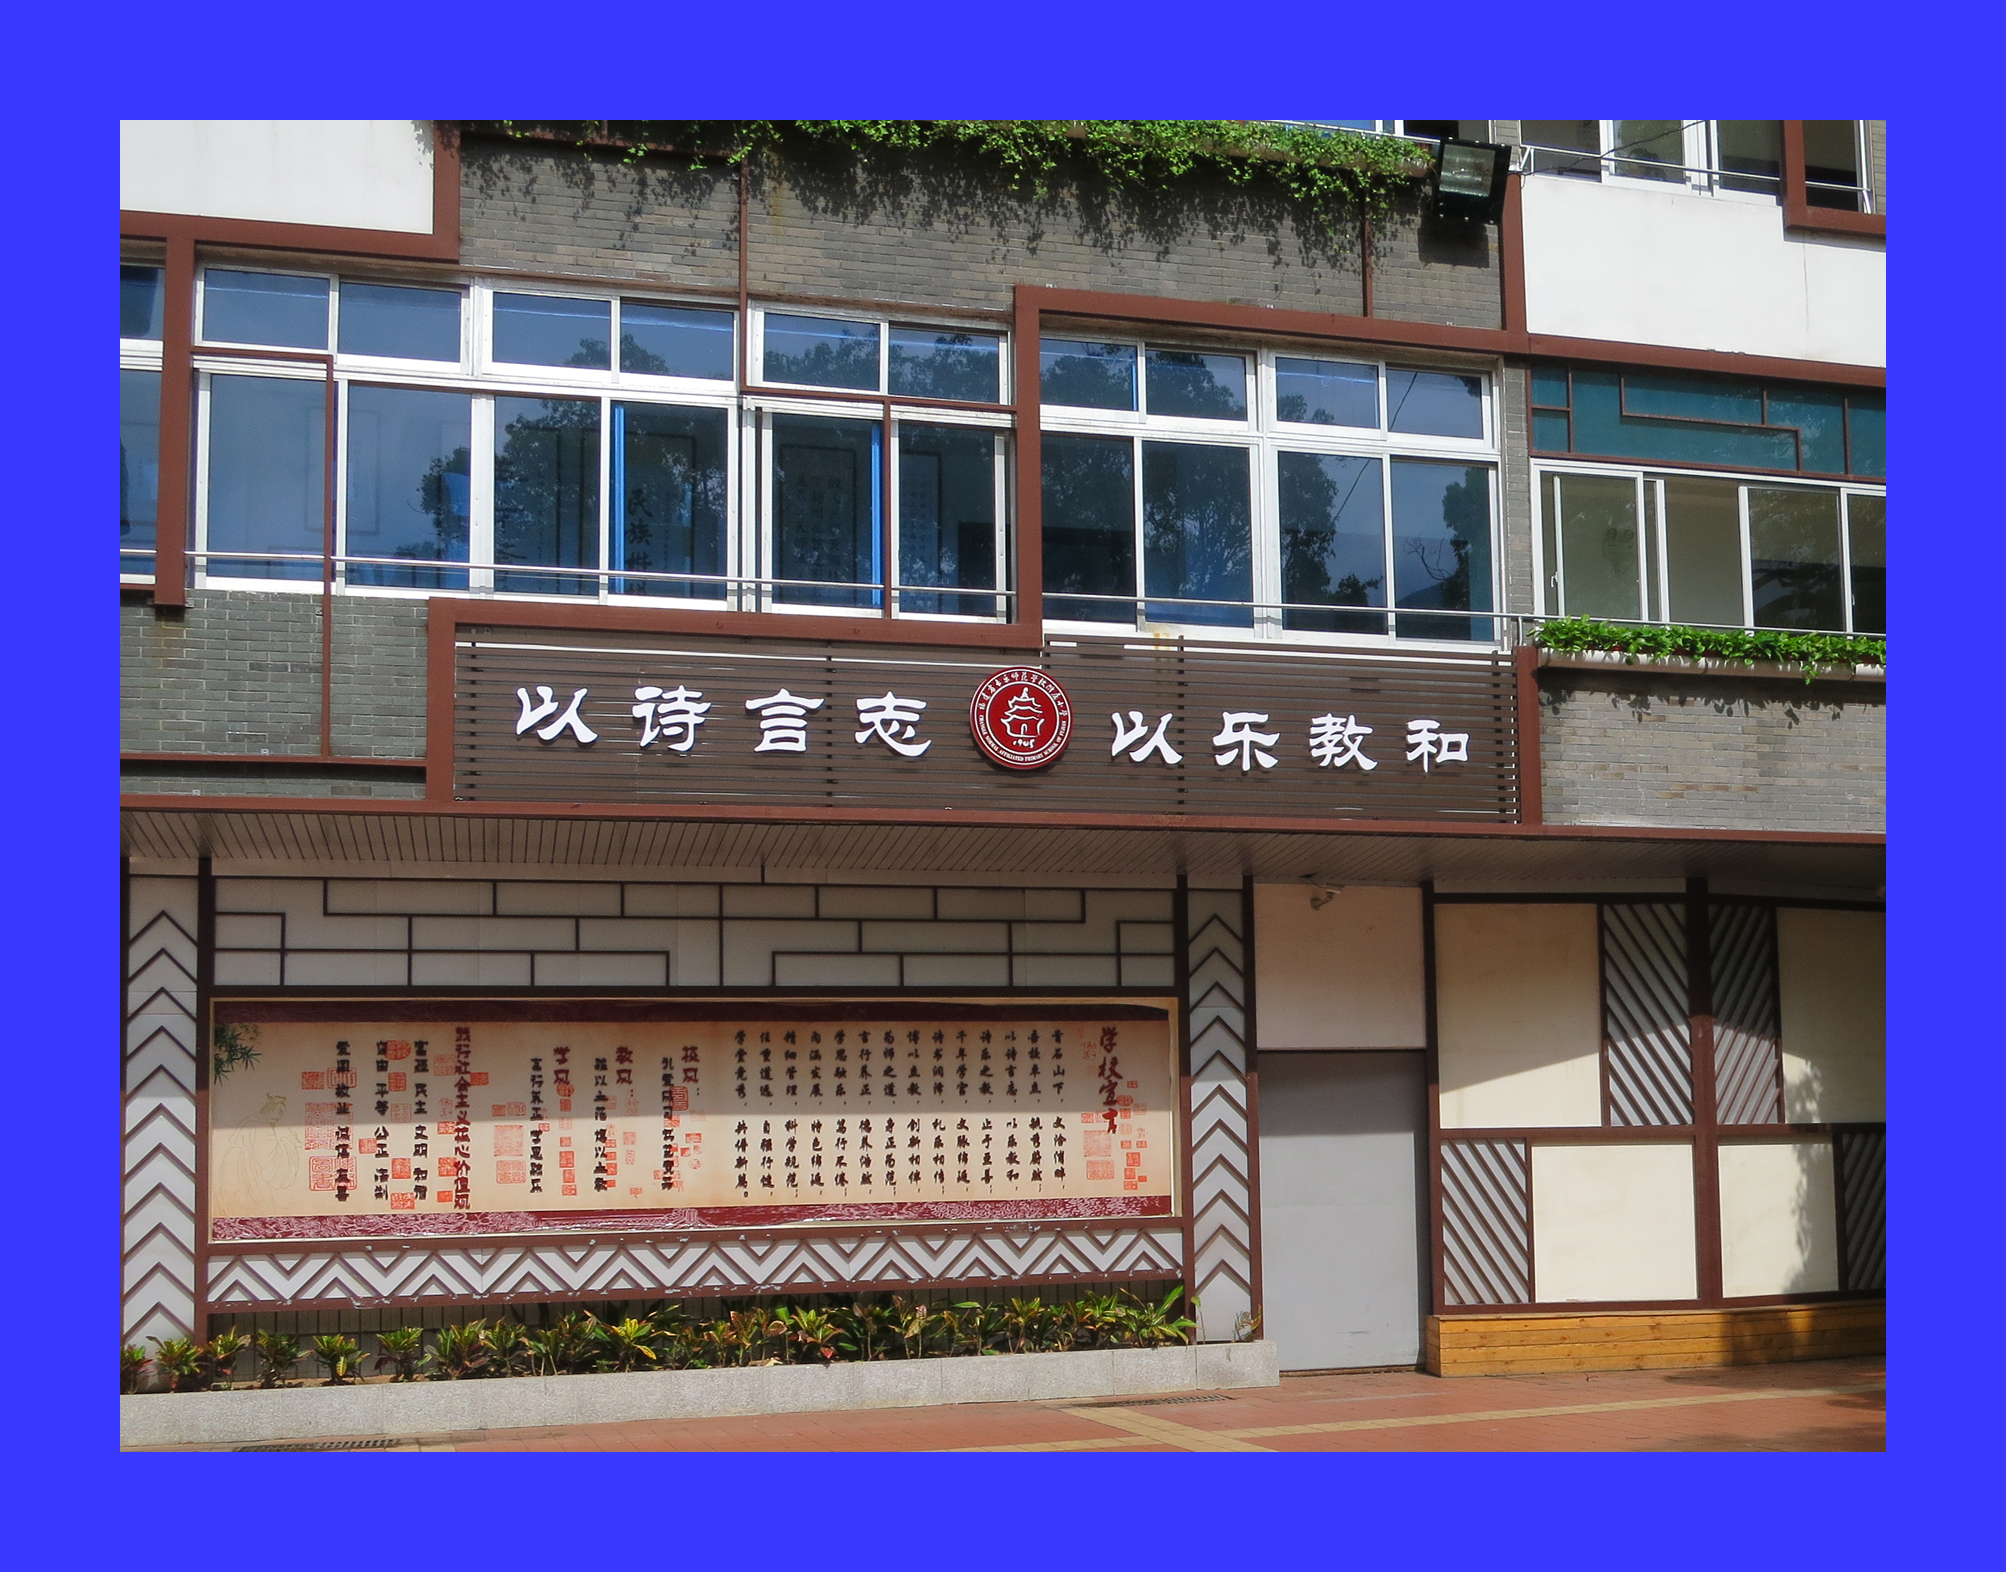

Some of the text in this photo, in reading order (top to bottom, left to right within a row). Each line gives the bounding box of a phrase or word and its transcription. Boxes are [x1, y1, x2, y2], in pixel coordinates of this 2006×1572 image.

[516, 684, 932, 758] 以诗言志
[1110, 710, 1461, 773] 以乐教和
[336, 1041, 350, 1073] 爱国
[376, 1040, 389, 1072] 自由
[1097, 1026, 1123, 1134] 学校宣言
[335, 1083, 350, 1115] 敬业
[375, 1083, 389, 1116] 平等
[413, 1040, 429, 1200] 富强 民主 文明 和谐
[454, 1027, 471, 1209] 践行社会主义核心价值观
[335, 1126, 350, 1159] 诚信
[374, 1126, 389, 1158] 公正
[335, 1168, 350, 1202] 友善
